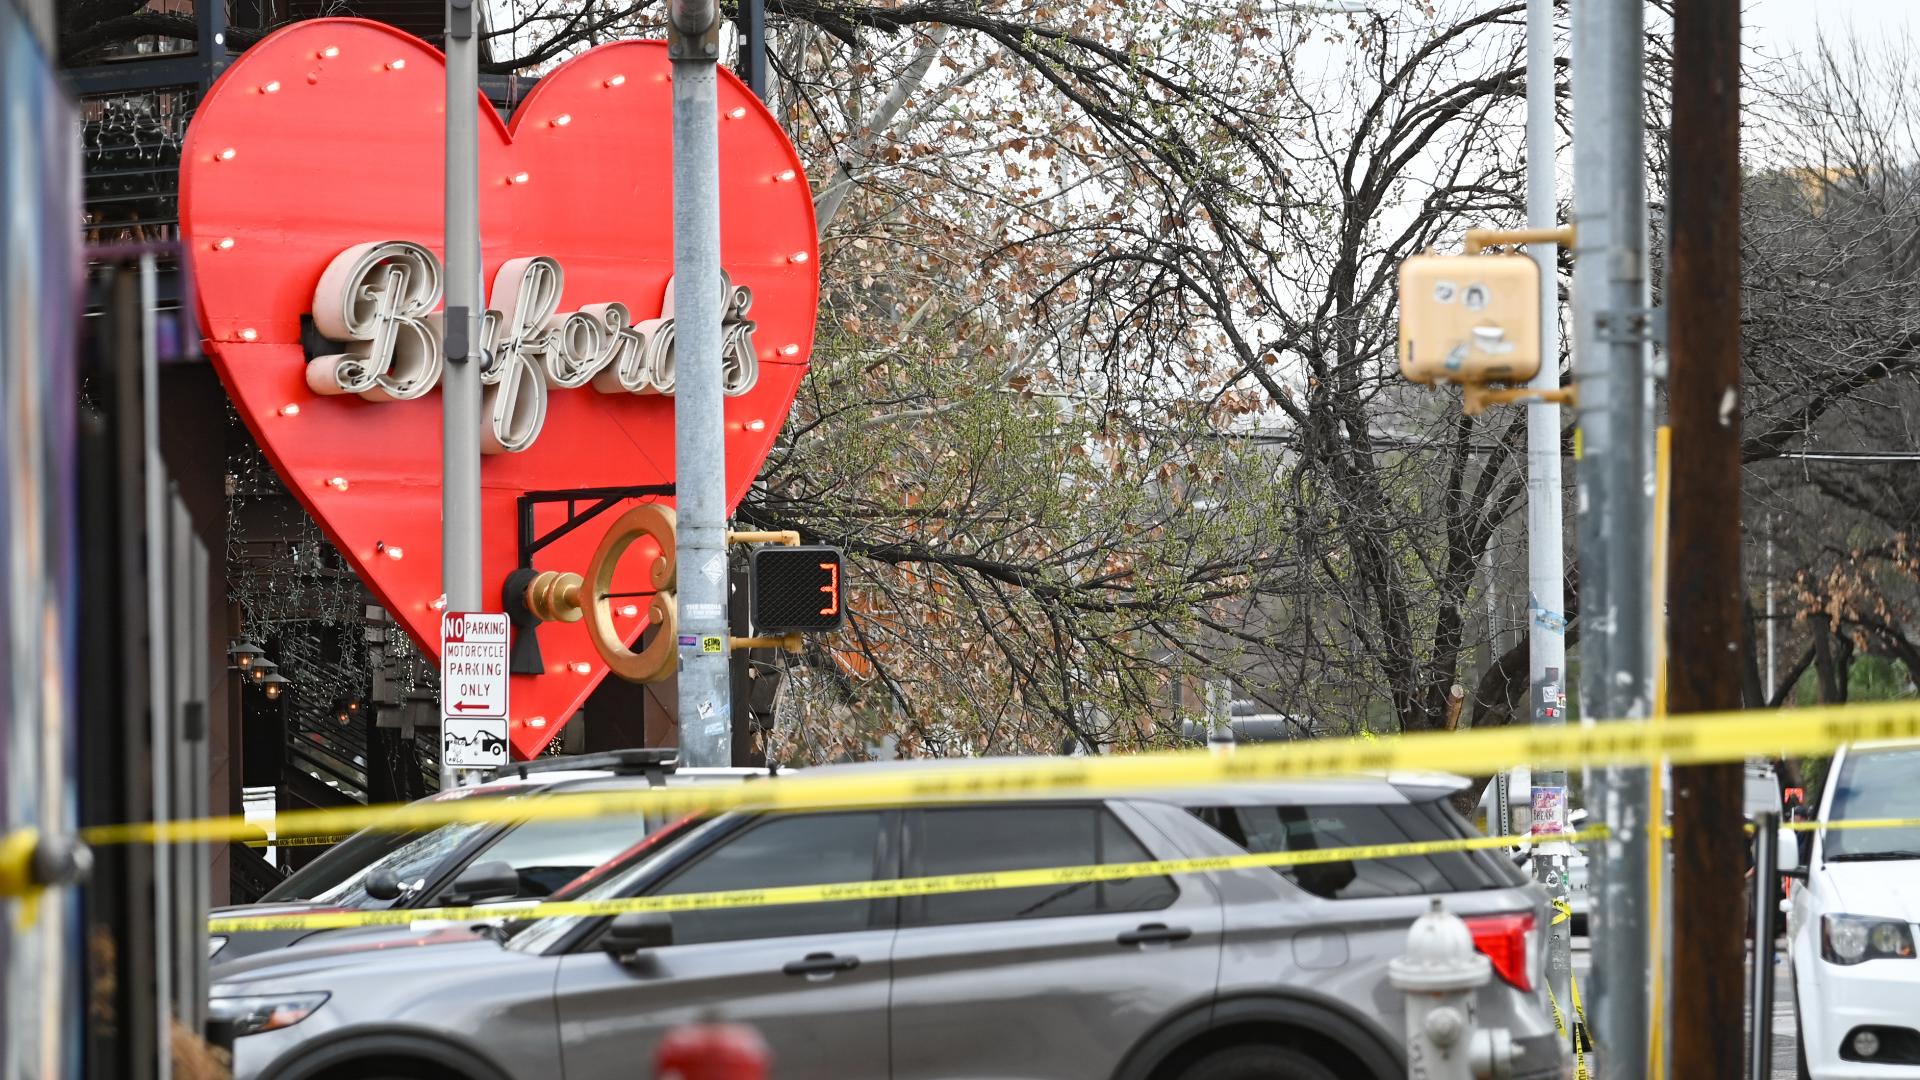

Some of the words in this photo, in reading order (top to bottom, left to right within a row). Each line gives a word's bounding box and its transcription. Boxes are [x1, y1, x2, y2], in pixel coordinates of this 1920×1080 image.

[819, 562, 837, 615] 3
[446, 617, 464, 638] NO
[465, 621, 505, 635] PARKING
[447, 645, 504, 658] MOTORCYCLE
[450, 662, 502, 676] PARKING
[460, 683, 491, 697] ONLY
